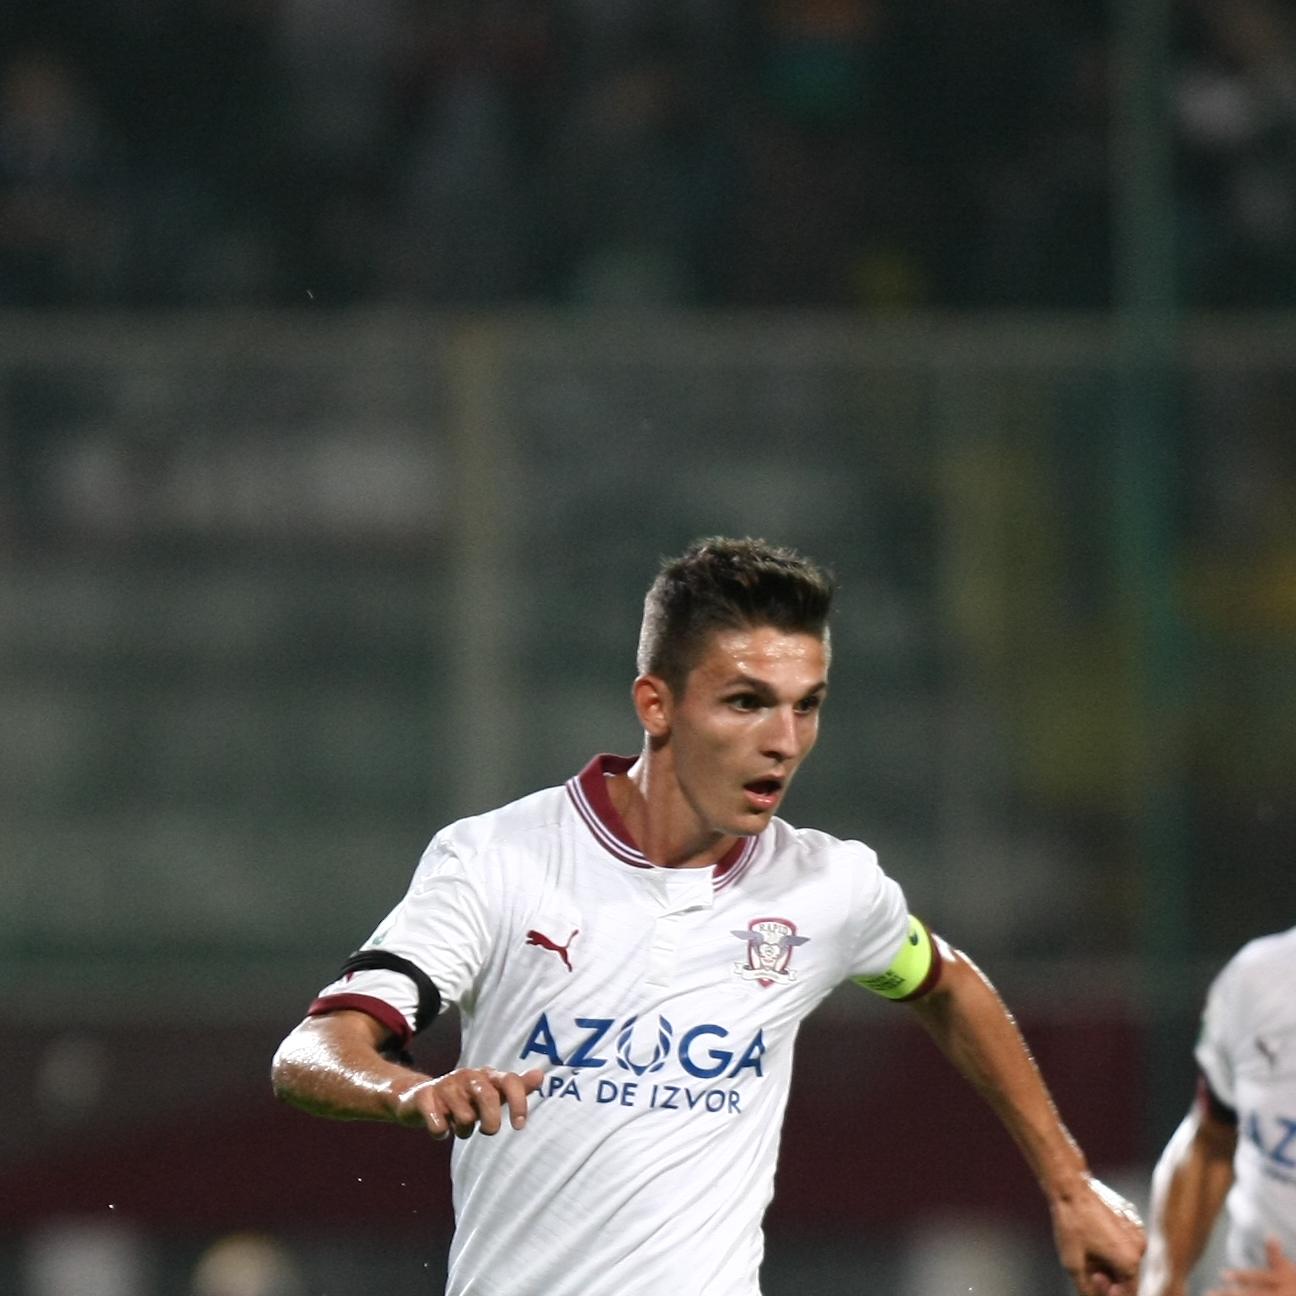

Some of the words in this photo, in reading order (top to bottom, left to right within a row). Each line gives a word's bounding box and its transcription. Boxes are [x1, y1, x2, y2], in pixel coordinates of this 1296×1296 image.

[519, 1012, 767, 1078] AZUGA
[596, 1079, 638, 1106] DE
[649, 1084, 741, 1114] IZVOR
